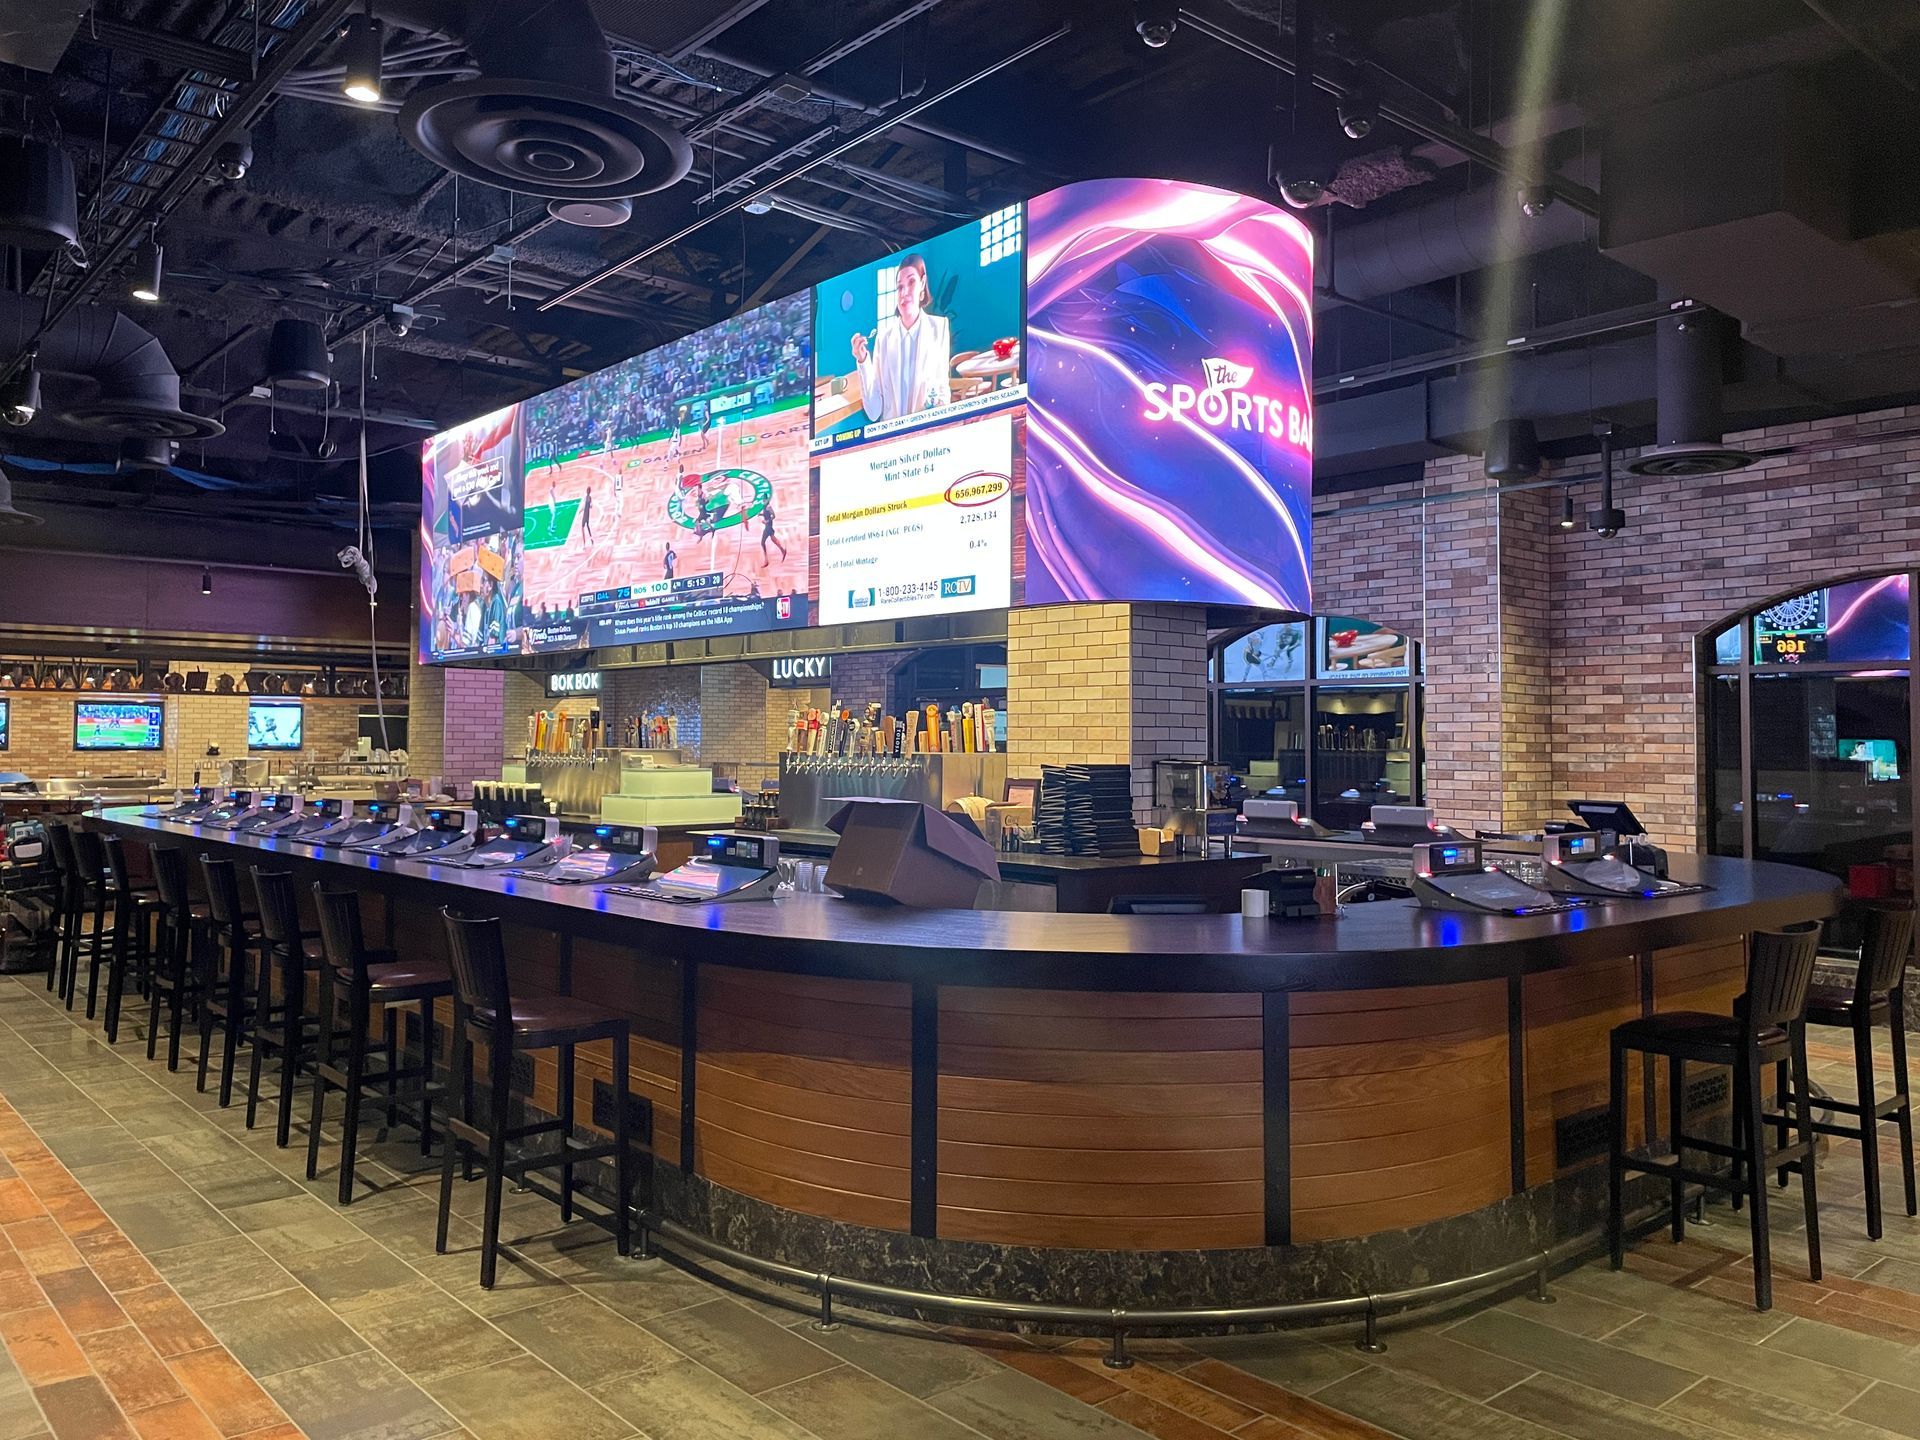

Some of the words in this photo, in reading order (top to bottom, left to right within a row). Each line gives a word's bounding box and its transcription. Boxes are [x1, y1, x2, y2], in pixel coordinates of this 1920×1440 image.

[1214, 365, 1237, 384] the
[1000, 389, 1020, 399] SEASON
[1143, 382, 1284, 439] SPORTS
[1288, 405, 1312, 451] BA
[870, 459, 897, 471] Morgan
[900, 453, 921, 464] Silver
[922, 447, 951, 459] Dollars
[884, 472, 900, 482] Mint
[902, 467, 921, 478] State
[923, 463, 935, 474] 64
[955, 482, 1003, 499] 656,967,299
[826, 513, 841, 523] Total
[841, 509, 864, 520] Morgan
[864, 505, 886, 516] Dollars
[887, 500, 907, 511] Struck
[960, 510, 997, 524] 2,728,134
[840, 559, 854, 568] Total
[597, 592, 609, 600] DAL
[617, 587, 630, 598] 75
[633, 586, 647, 594] BOS
[651, 582, 669, 592] 100
[687, 577, 706, 588] 5:13
[878, 580, 939, 598] 1-800-233-4145
[944, 579, 971, 595] RCTV
[672, 612, 686, 620] among
[708, 607, 722, 616] record
[678, 620, 700, 629] champions
[713, 616, 724, 625] NBA
[723, 615, 733, 625] App
[773, 656, 826, 679] LUCKY
[551, 673, 574, 692] BOK
[575, 672, 599, 690] BOK
[894, 729, 903, 753] TOLOSA
